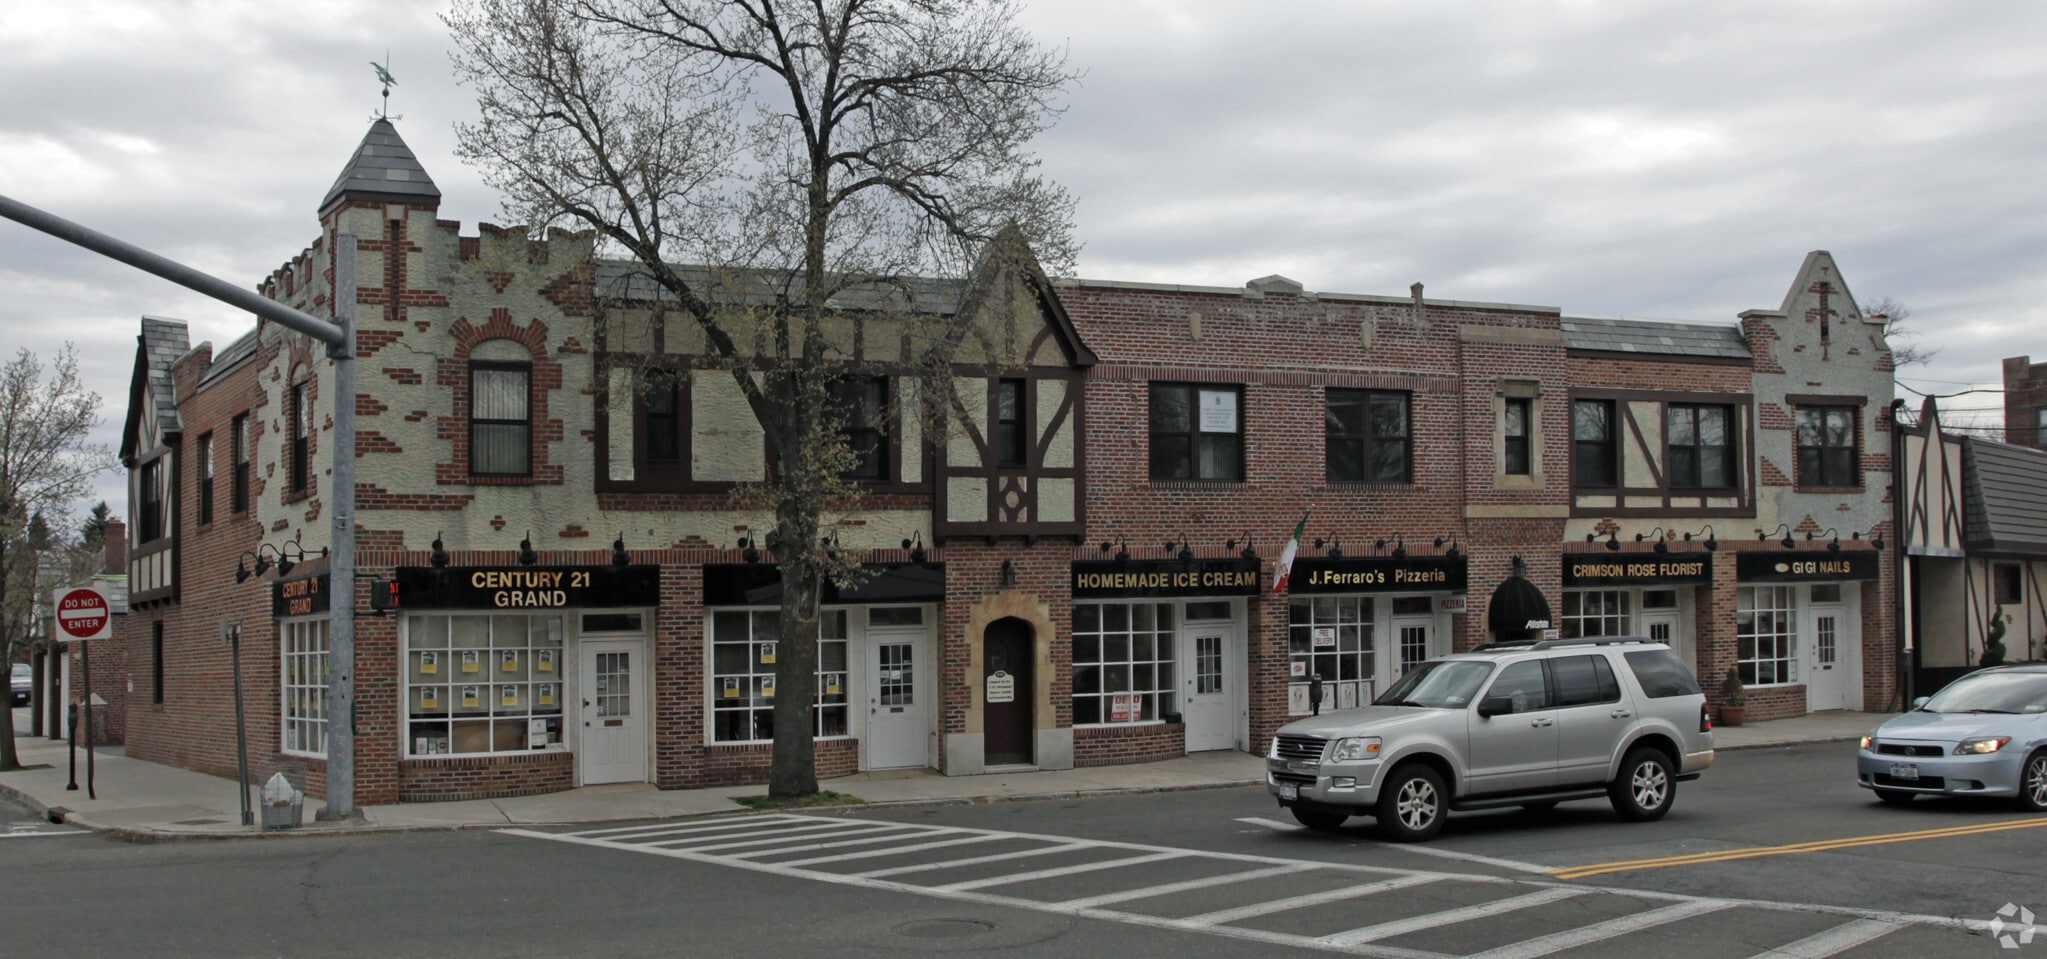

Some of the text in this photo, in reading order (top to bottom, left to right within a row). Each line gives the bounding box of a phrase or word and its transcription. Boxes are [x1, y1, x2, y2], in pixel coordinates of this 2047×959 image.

[1573, 562, 1703, 577] CRIMSON ROSE FLORIST
[1820, 560, 1851, 573] NAILS
[471, 571, 591, 588] CENTURY 21
[1077, 571, 1256, 588] HOMEMADE ICE CREAM
[1395, 568, 1446, 583] Pizzeria
[283, 577, 319, 598] CENTURY 21
[65, 598, 99, 608] DO NOT
[290, 597, 312, 615] GRAND
[494, 590, 567, 607] GRAND
[68, 619, 99, 629] ENTER
